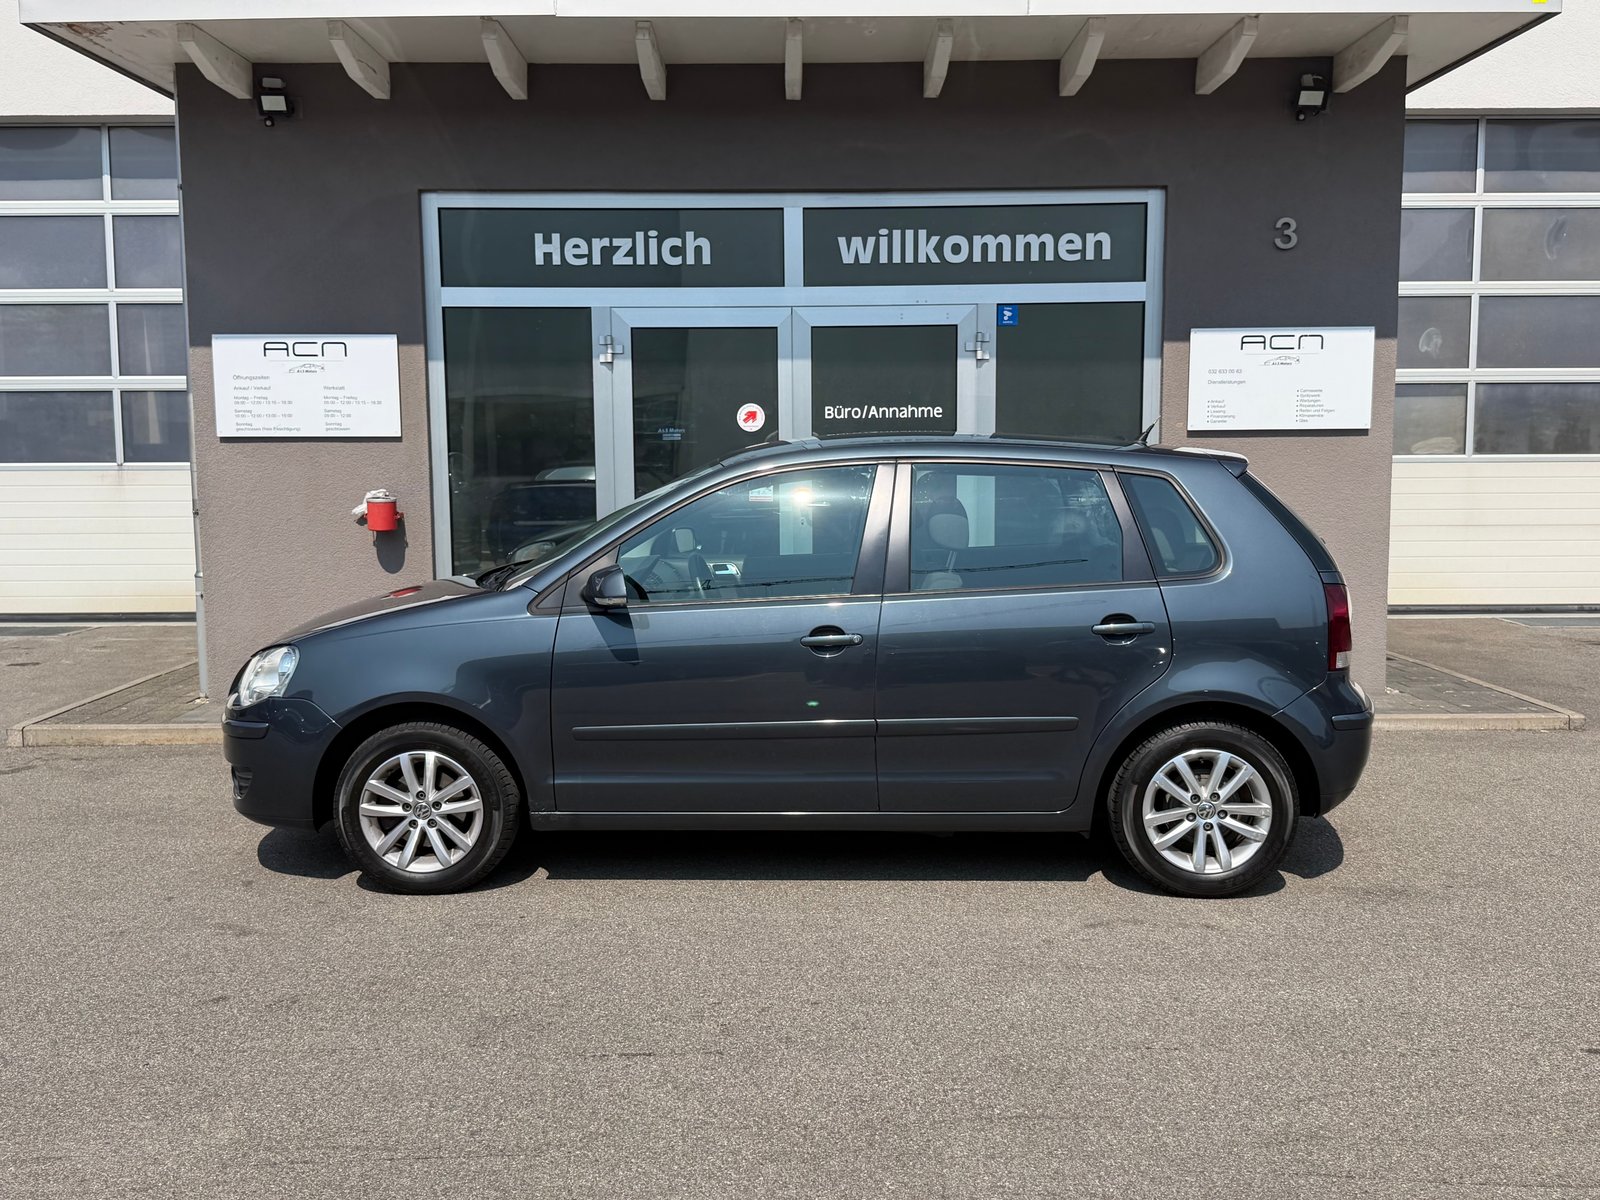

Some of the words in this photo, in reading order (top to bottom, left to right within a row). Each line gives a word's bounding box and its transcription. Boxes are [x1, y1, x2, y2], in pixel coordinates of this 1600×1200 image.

[535, 231, 710, 265] Herzlich
[838, 229, 1110, 263] willkommen
[1274, 217, 1298, 250] 3
[825, 405, 942, 419] Büro/Annahme
